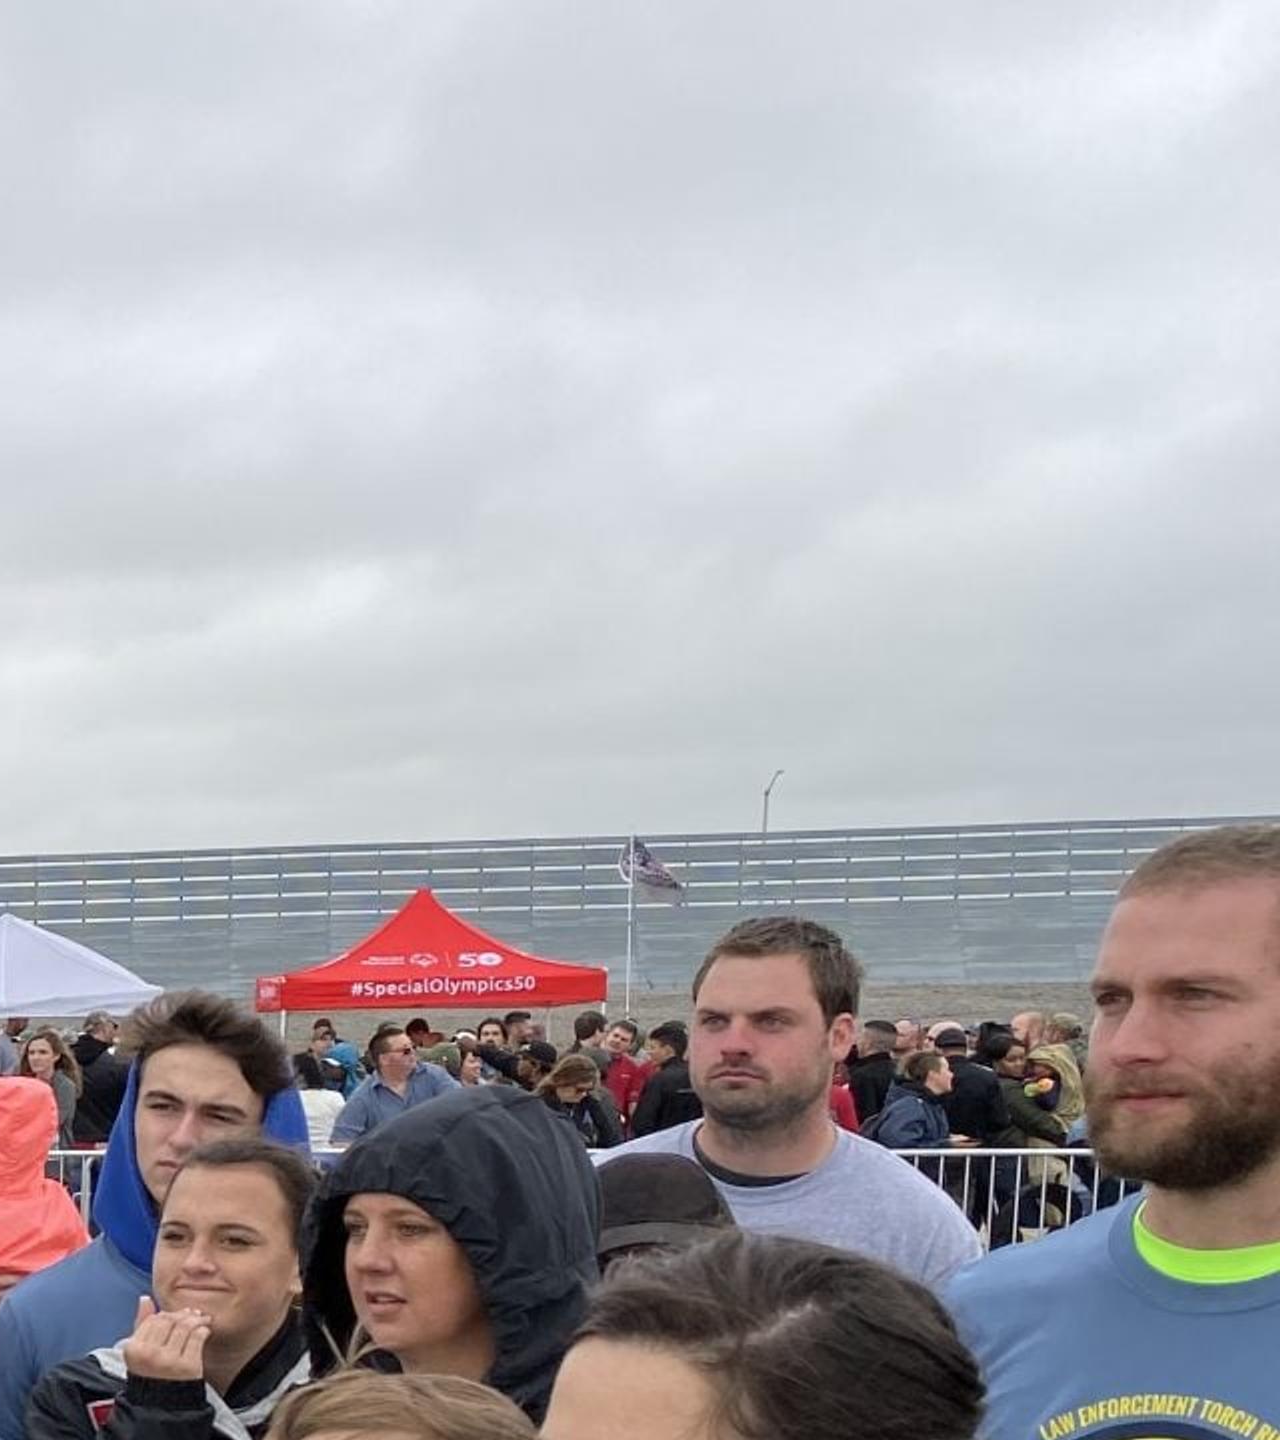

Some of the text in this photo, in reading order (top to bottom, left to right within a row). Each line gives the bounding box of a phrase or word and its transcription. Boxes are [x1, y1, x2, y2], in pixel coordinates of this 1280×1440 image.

[351, 976, 536, 998] #SpecialOlympics50
[1078, 1395, 1198, 1427] ENFORCEMENT
[1200, 1400, 1257, 1438] TORCH
